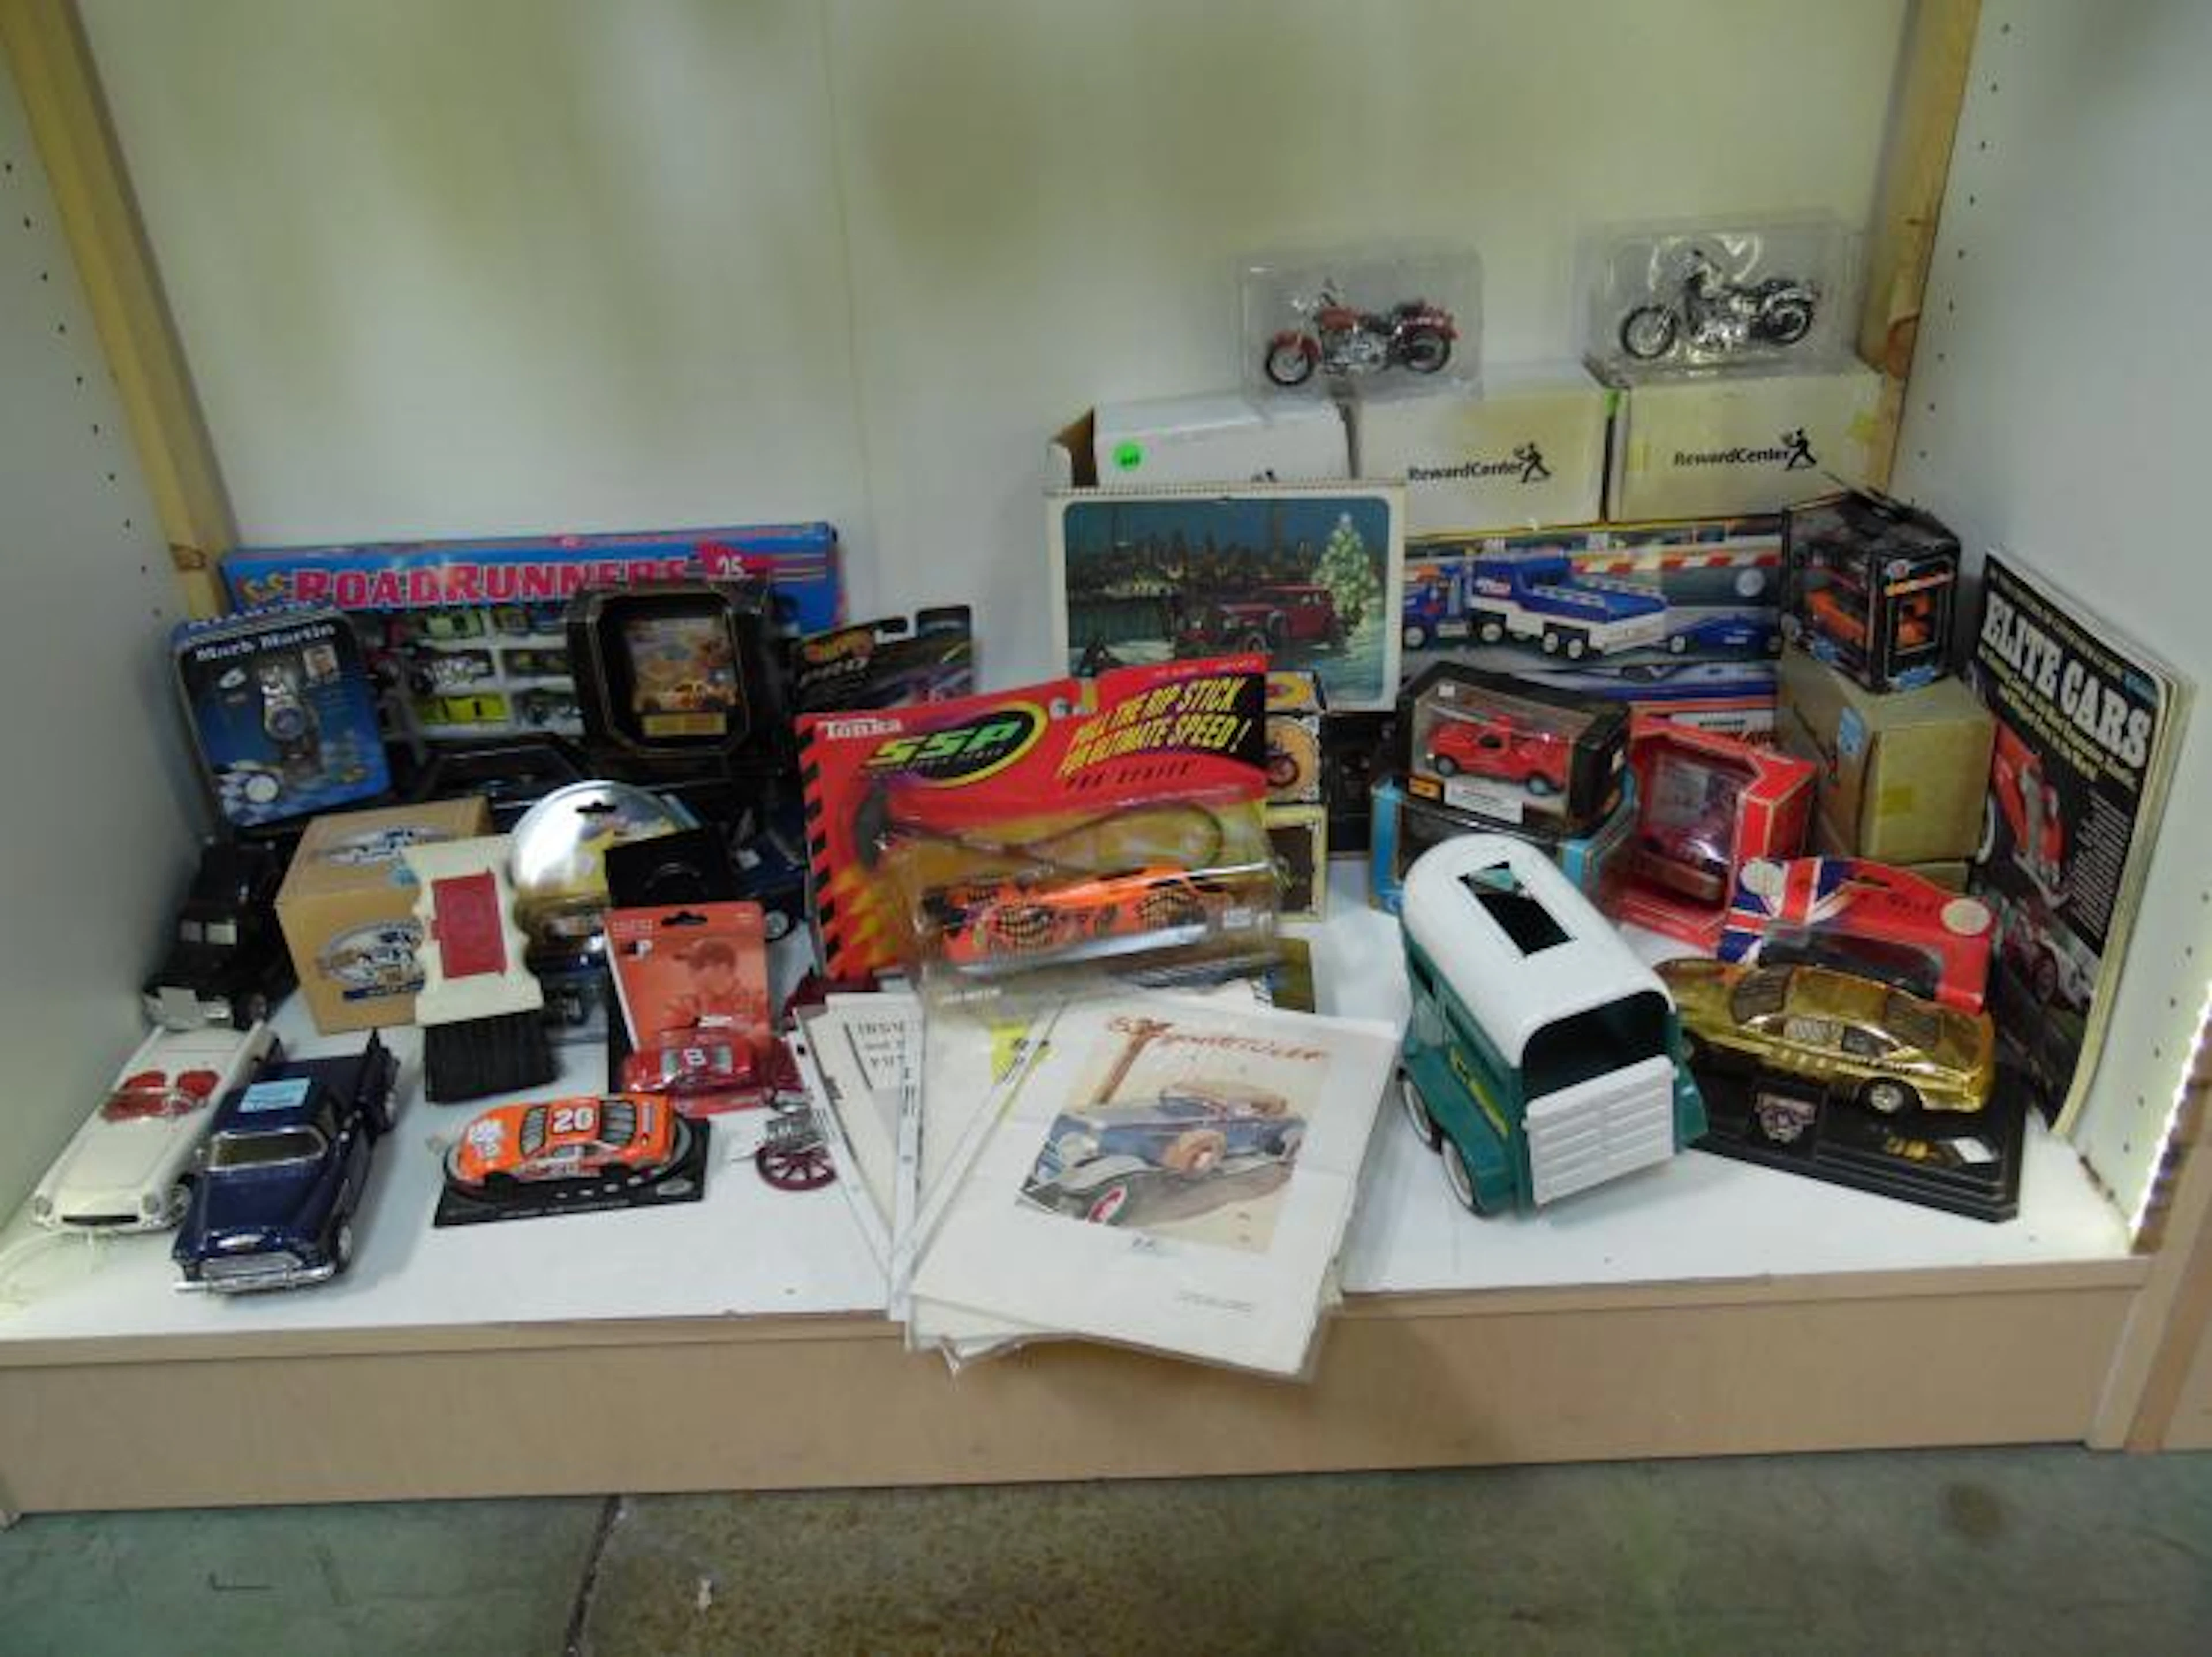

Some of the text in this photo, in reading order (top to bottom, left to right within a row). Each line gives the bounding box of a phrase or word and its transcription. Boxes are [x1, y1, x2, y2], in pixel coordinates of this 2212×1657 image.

[1674, 446, 1790, 467] RewardCenter
[1407, 461, 1524, 482] RewardCenter
[1980, 590, 2063, 700] ELITE
[2059, 660, 2152, 769] CARS
[816, 718, 904, 739] Tonka
[859, 719, 1024, 767] SSP
[552, 1106, 595, 1134] 20
